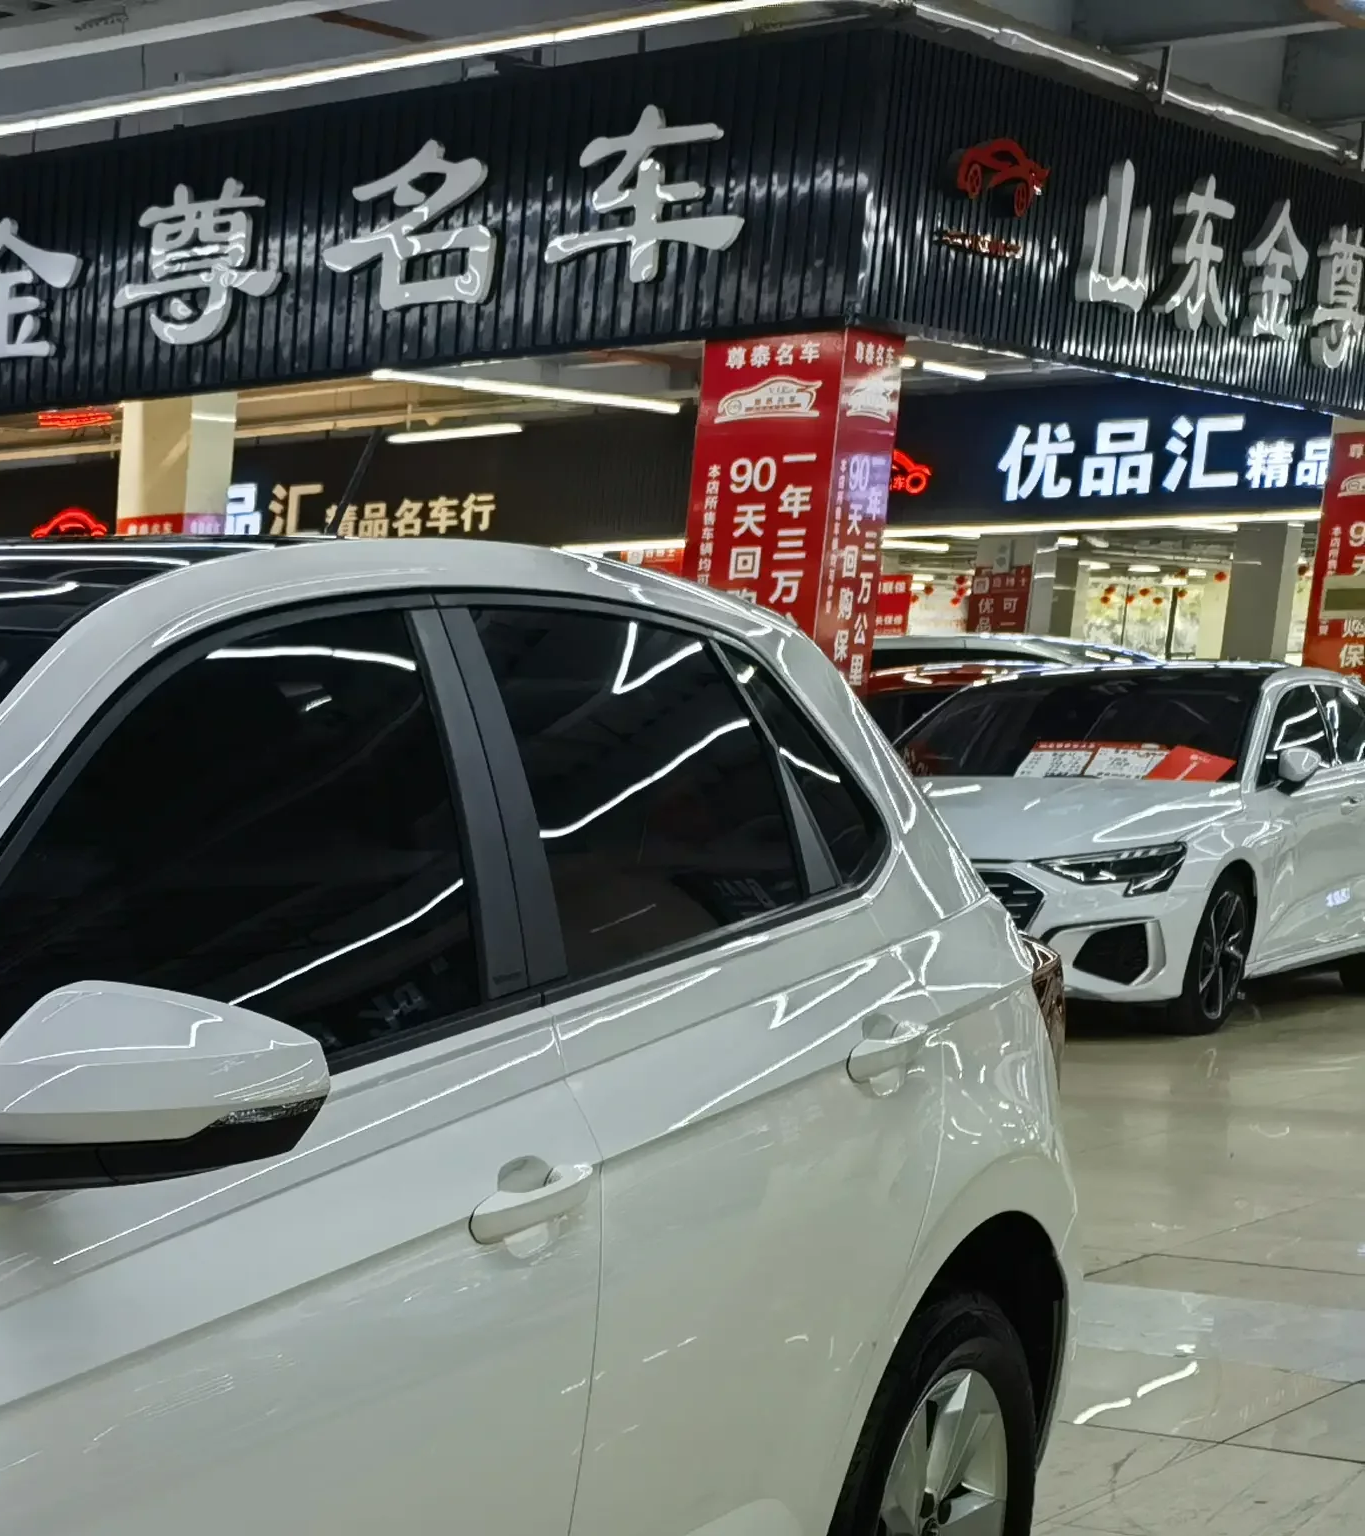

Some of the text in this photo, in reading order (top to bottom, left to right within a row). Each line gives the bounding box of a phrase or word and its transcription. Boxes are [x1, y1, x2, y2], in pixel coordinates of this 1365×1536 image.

[1075, 159, 1365, 368] 山东金尊
[726, 341, 821, 369] 尊泰名车
[997, 413, 1246, 501] 优品汇
[769, 453, 817, 627] 一年三万
